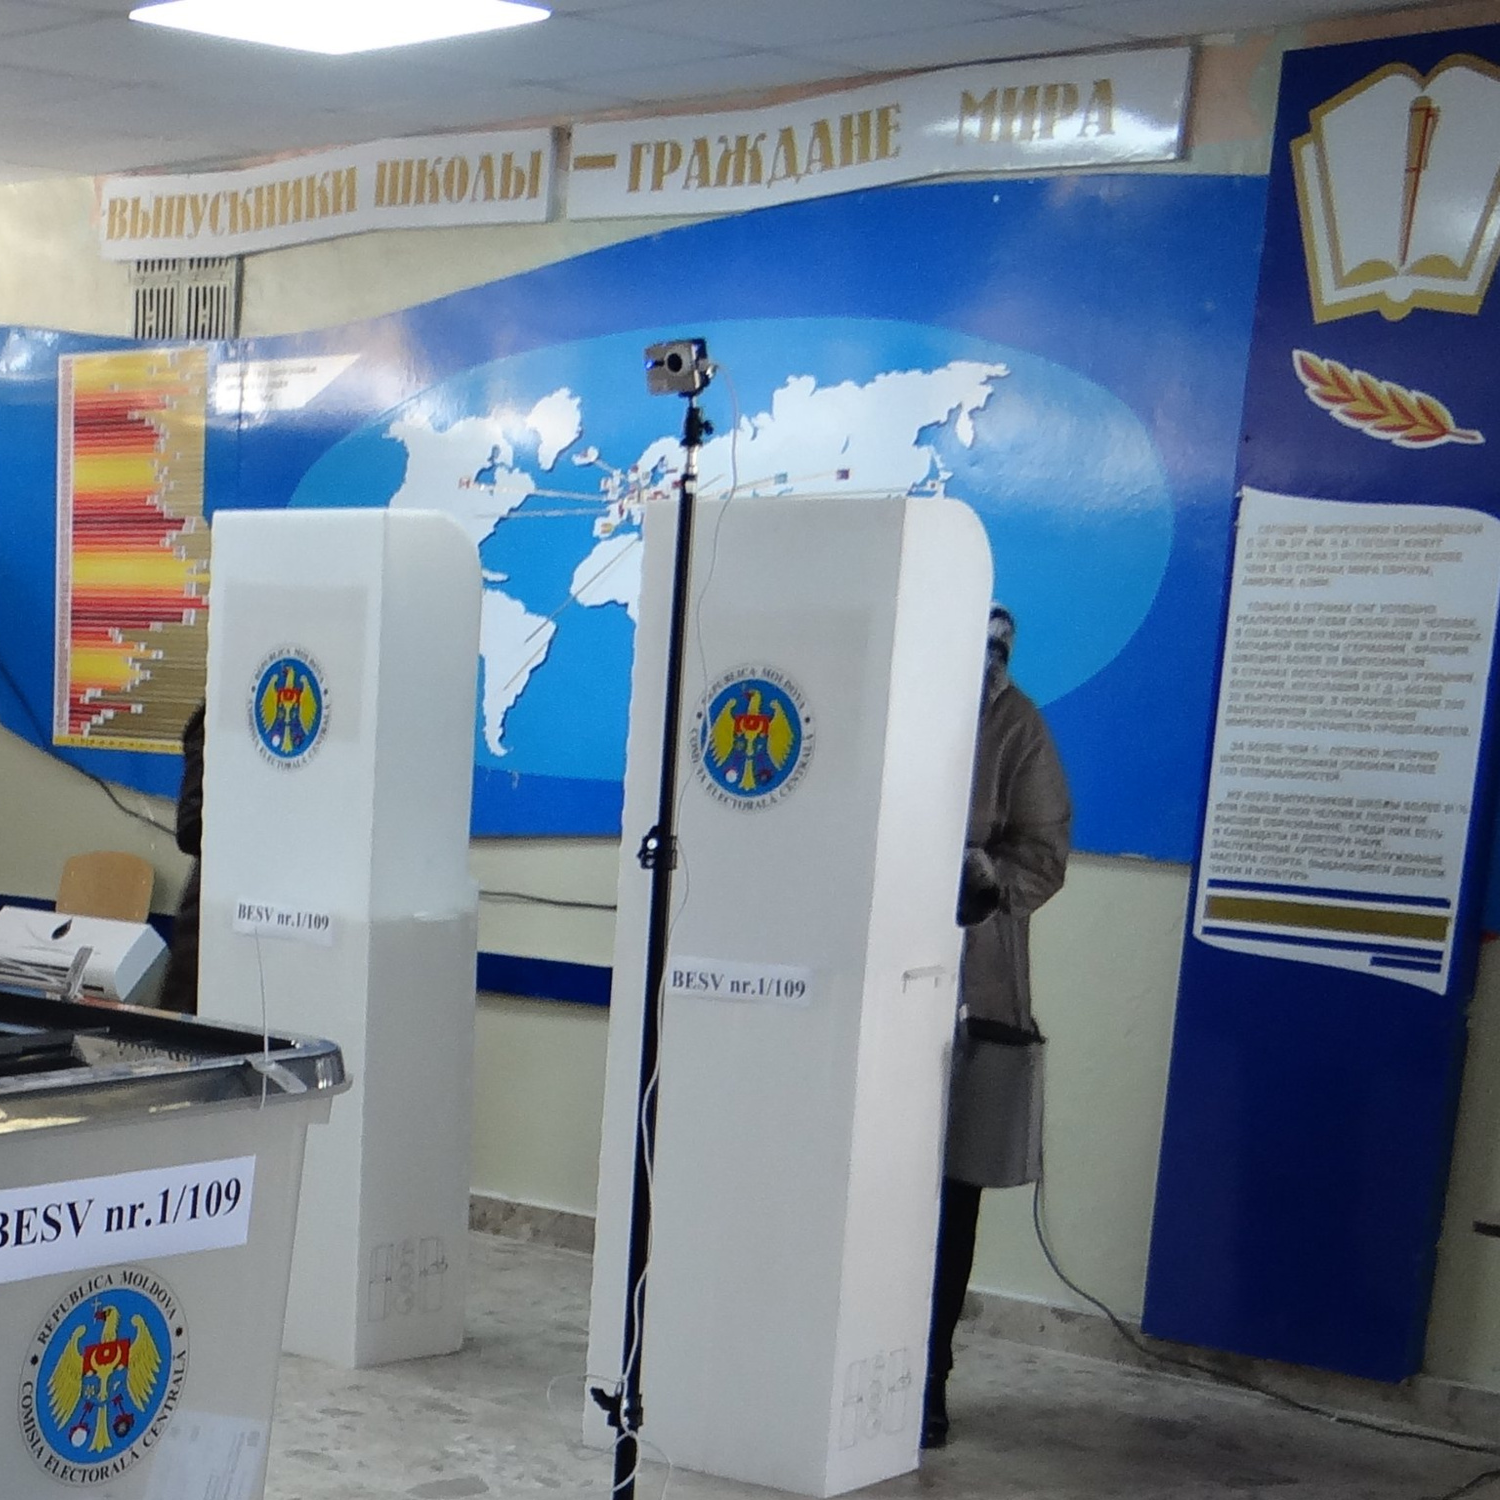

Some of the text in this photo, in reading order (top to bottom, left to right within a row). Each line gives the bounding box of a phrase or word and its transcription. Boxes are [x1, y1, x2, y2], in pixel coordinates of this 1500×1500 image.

[106, 167, 358, 240] ВЫПУСКНИКИ
[374, 149, 543, 208] ШКОЛЫ
[627, 104, 900, 193] ГРАЖДАНЕ
[956, 78, 1116, 146] МИРА
[238, 903, 329, 930] BESV nr.1/109
[672, 970, 806, 999] BESV nr.1/109
[104, 1177, 242, 1234] nr.1/109
[37, 1270, 176, 1345] REPUBLICA MOLDOVA
[21, 1381, 43, 1459] COMISIA
